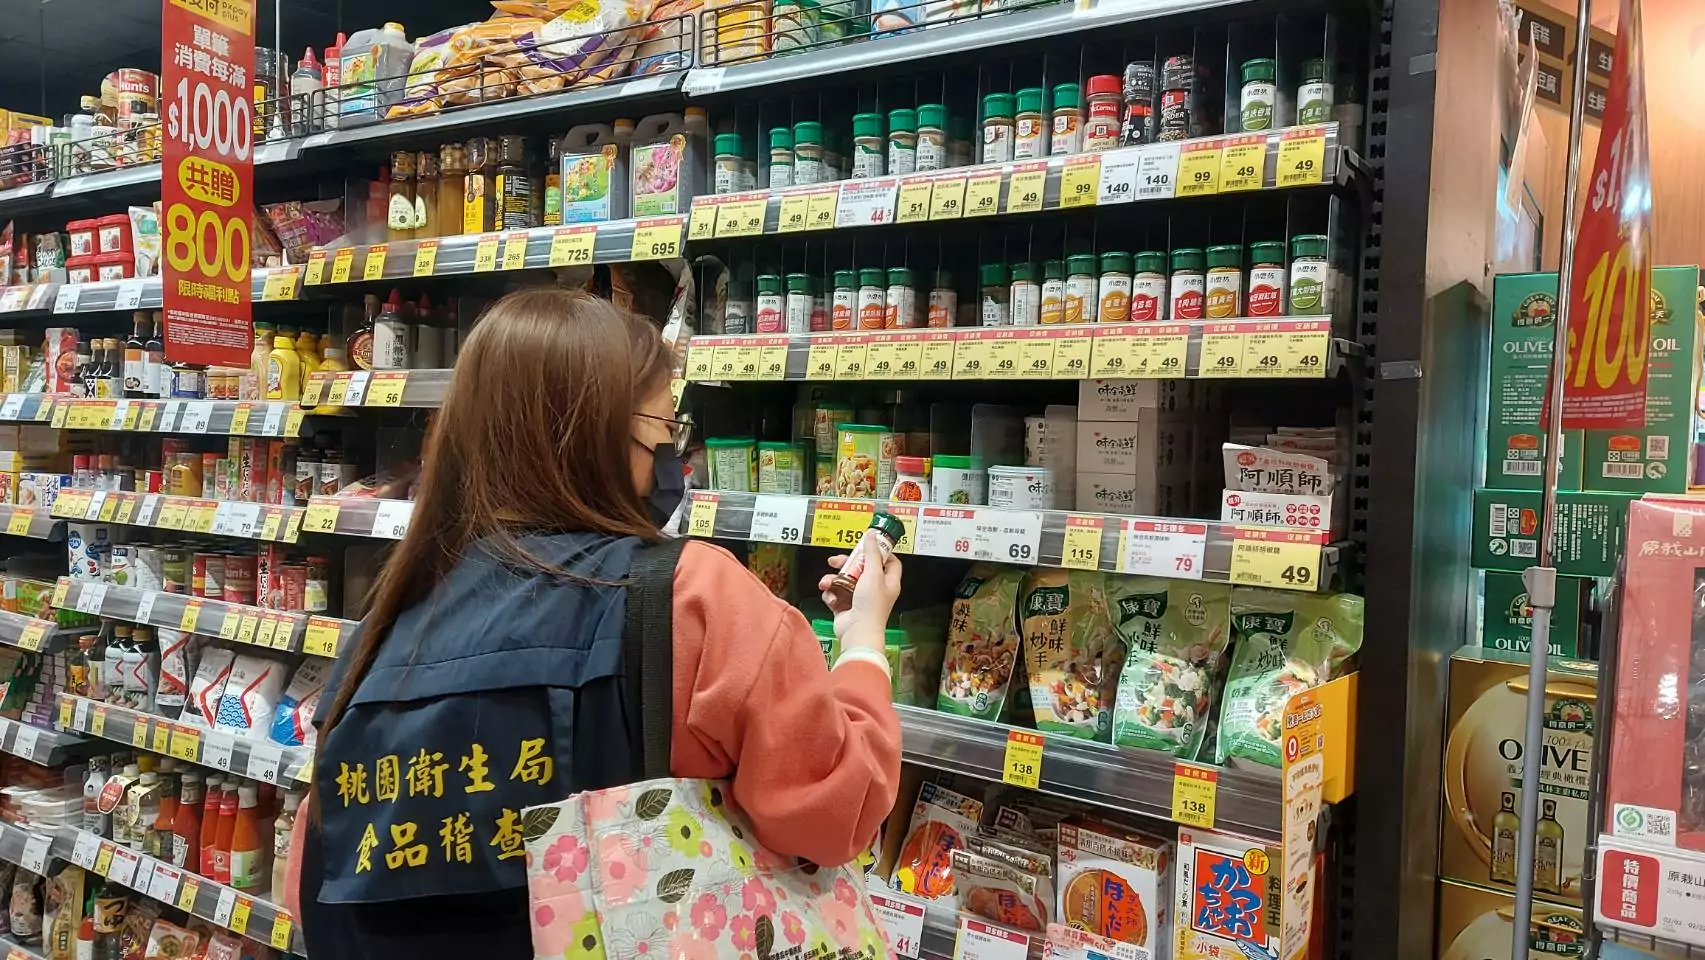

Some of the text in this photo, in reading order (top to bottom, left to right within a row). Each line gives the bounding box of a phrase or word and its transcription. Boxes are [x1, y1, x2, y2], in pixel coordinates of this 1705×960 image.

[193, 24, 229, 56] 單筆
[174, 42, 246, 89] 消費每滿
[168, 77, 250, 161] $1,000
[1295, 160, 1314, 170] 49
[1237, 166, 1255, 176] 49
[1145, 174, 1169, 185] 140
[1194, 171, 1211, 182] 99
[186, 162, 234, 202] 共贈
[1076, 184, 1091, 194] 99
[1106, 183, 1130, 194] 140
[979, 197, 993, 206] 49
[1022, 192, 1038, 202] 49
[910, 203, 923, 213] 51
[943, 199, 957, 209] 49
[790, 214, 802, 223] 49
[817, 211, 829, 220] 49
[698, 223, 709, 231] 51
[727, 220, 738, 229] 49
[749, 218, 760, 226] 49
[167, 203, 250, 282] 800
[651, 243, 675, 255] 695
[567, 249, 589, 261] 725
[178, 279, 239, 304] 限時福利點
[279, 286, 291, 296] 32
[1503, 341, 1548, 354] OLIVE
[1653, 338, 1681, 351] OIL
[876, 361, 889, 370] 49
[902, 361, 915, 370] 49
[933, 360, 947, 370] 49
[966, 360, 980, 369] 49
[998, 359, 1013, 369] 49
[1032, 359, 1047, 369] 49
[1067, 358, 1083, 369] 49
[1107, 357, 1123, 367] 49
[1162, 357, 1179, 367] 49
[1217, 356, 1235, 366] 49
[1259, 356, 1278, 366] 49
[1300, 355, 1319, 366] 49
[696, 364, 707, 372] 49
[722, 363, 733, 372] 49
[743, 363, 755, 372] 49
[769, 363, 781, 371] 49
[818, 363, 831, 371] 49
[847, 362, 860, 371] 49
[386, 393, 398, 403] 56
[195, 421, 205, 430] 89
[1239, 467, 1322, 493] 阿順師
[1230, 508, 1281, 525] 阿順師
[241, 523, 251, 533] 79
[321, 519, 333, 529] 22
[695, 519, 710, 528] 105
[393, 525, 405, 536] 60
[781, 527, 800, 541] 59
[954, 539, 970, 552] 69
[1008, 543, 1032, 559] 69
[1071, 548, 1093, 560] 115
[1175, 557, 1193, 572] 79
[225, 568, 251, 578] unts
[1281, 566, 1311, 584] 49
[1030, 593, 1064, 612] 康寶
[1121, 599, 1161, 617] 康寶
[1242, 616, 1286, 633] 康寶
[1049, 619, 1067, 653] 鮮味
[1140, 620, 1161, 654] 鮮味
[322, 642, 333, 652] 18
[1495, 637, 1530, 652] OLIV
[1029, 631, 1049, 669] 炒手
[185, 748, 194, 757] 59
[1498, 738, 1589, 773] OIVE
[217, 757, 227, 767] 49
[335, 738, 554, 807] 桃園衛生局
[1012, 762, 1033, 775] 138
[263, 770, 274, 780] 49
[1181, 799, 1206, 813] 138
[355, 808, 526, 874] 食品稽查
[33, 861, 41, 870] 35
[1249, 851, 1266, 873] 新
[1620, 859, 1640, 919] 特價商品
[1197, 942, 1220, 958] 小袋
